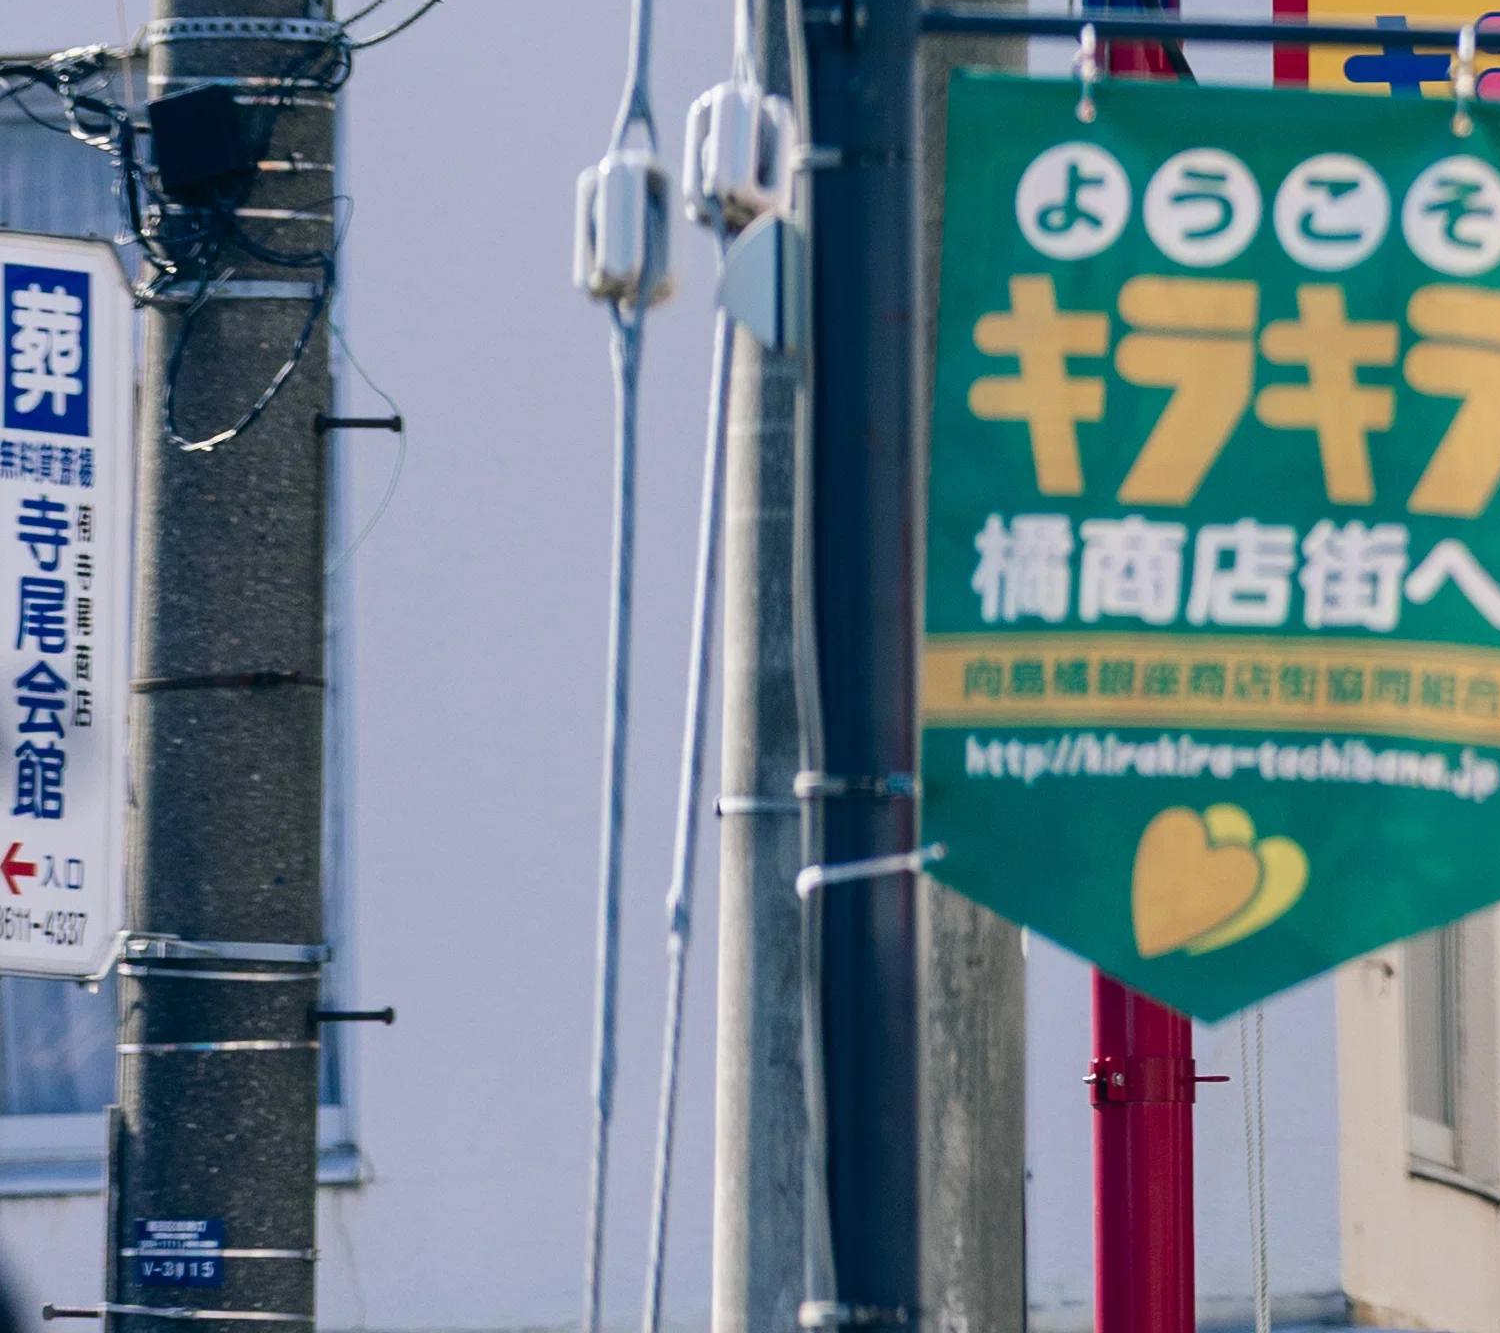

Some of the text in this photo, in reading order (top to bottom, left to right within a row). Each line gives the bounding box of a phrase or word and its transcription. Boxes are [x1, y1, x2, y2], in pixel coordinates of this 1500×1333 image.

[1030, 157, 1500, 257] ようこそ
[10, 281, 83, 417] 葬
[11, 493, 71, 821] 寺尾会館
[40, 855, 85, 890] 入口
